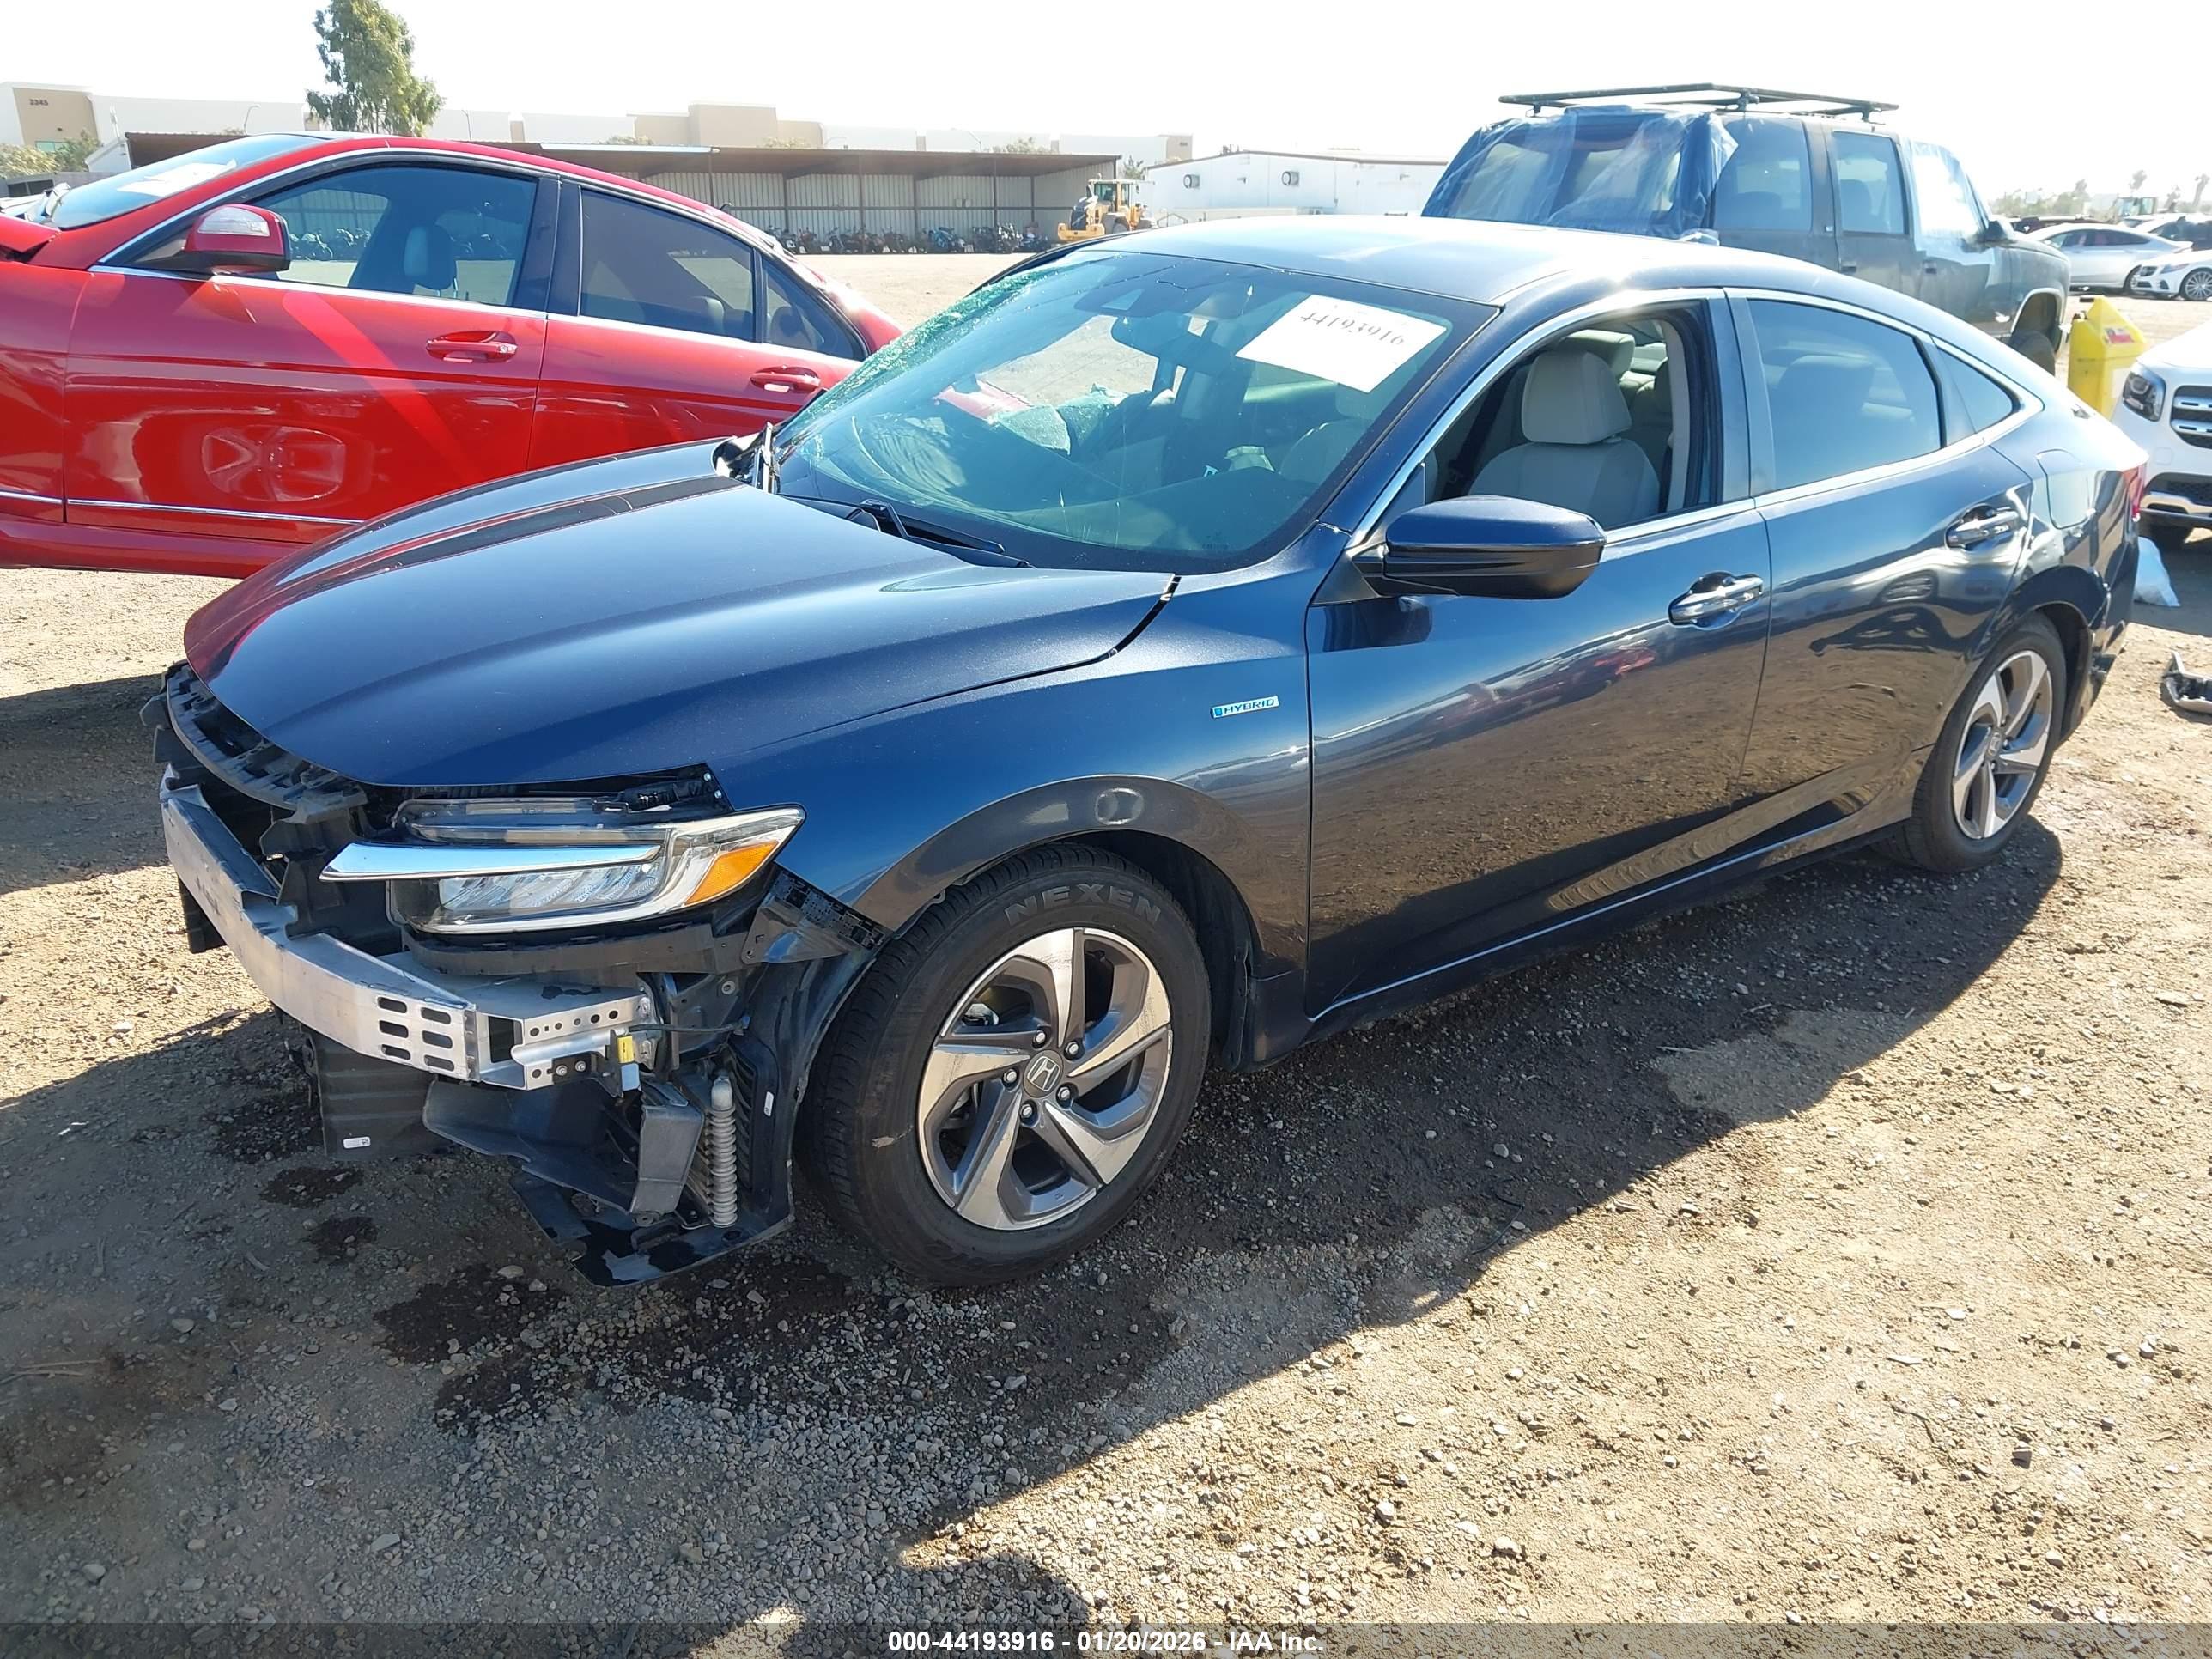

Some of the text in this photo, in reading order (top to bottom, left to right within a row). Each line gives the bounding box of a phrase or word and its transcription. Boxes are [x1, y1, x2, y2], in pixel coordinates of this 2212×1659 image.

[1300, 311, 1405, 346] 44193916
[1224, 698, 1275, 714] HYBRID
[1004, 883, 1161, 926] NEXEN
